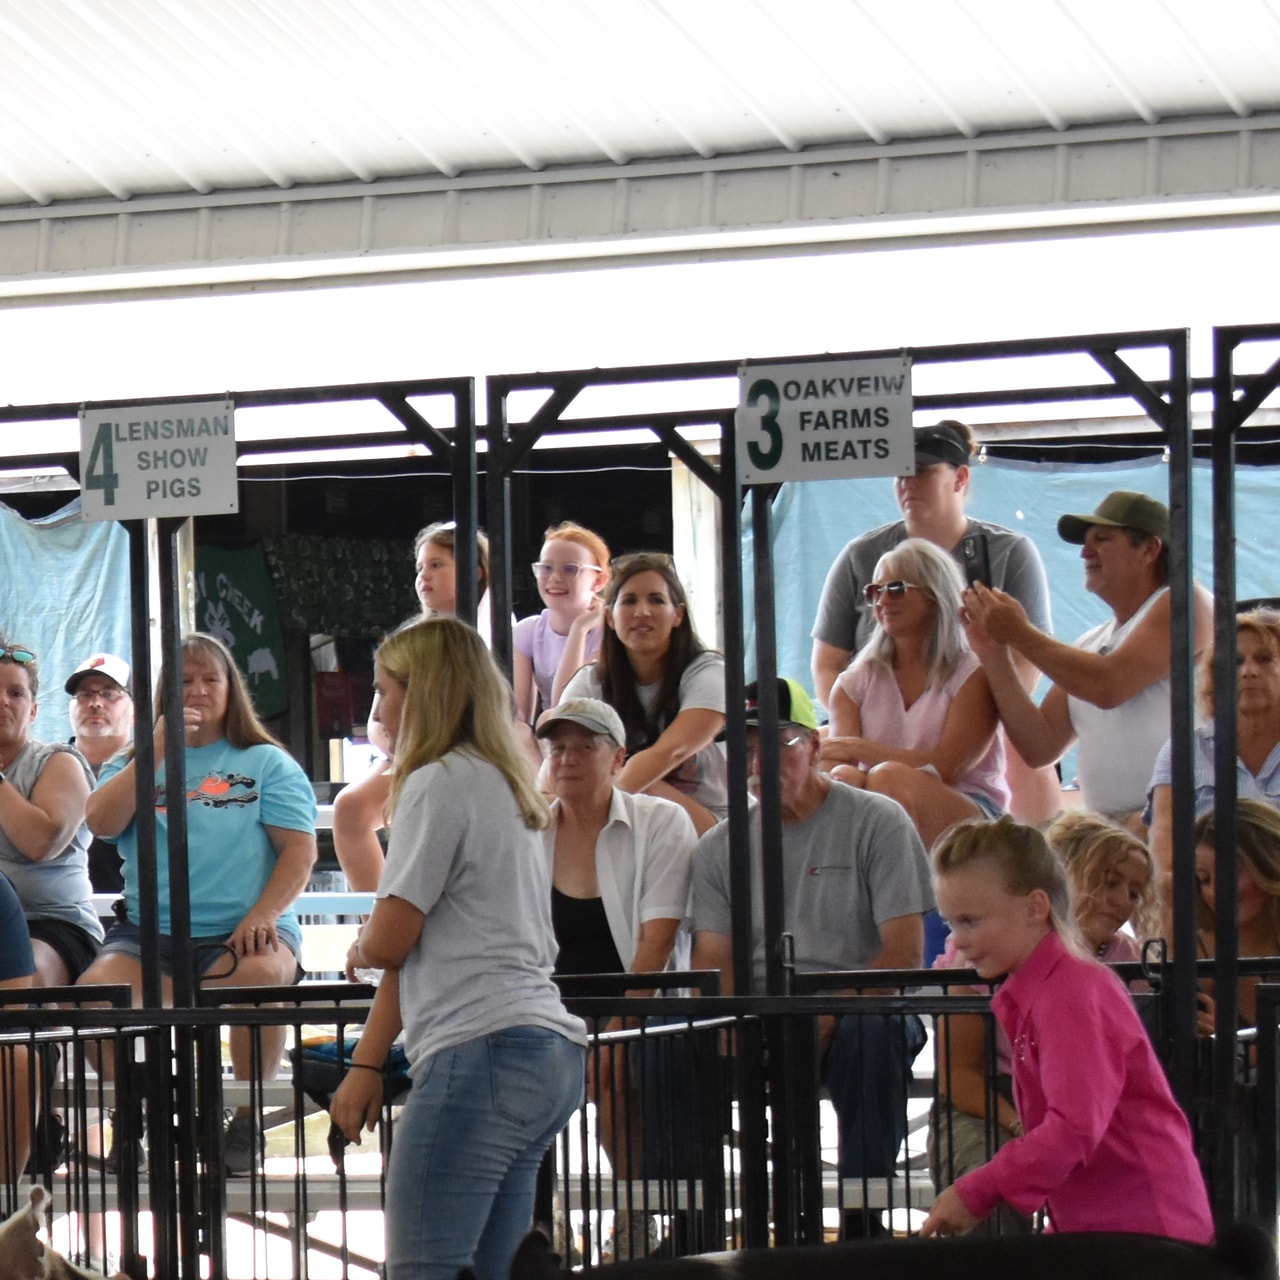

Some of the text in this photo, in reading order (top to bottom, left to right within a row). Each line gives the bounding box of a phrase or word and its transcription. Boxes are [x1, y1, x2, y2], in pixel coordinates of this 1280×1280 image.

[783, 374, 906, 401] OAKVEIW
[114, 415, 229, 442] LENSMAN
[746, 378, 783, 471] 3
[799, 406, 890, 432] FARMS
[137, 447, 208, 471] SHOW
[801, 438, 890, 462] MEATS
[85, 422, 119, 506] 4
[146, 477, 201, 500] PIGS
[215, 572, 265, 636] CREEK
